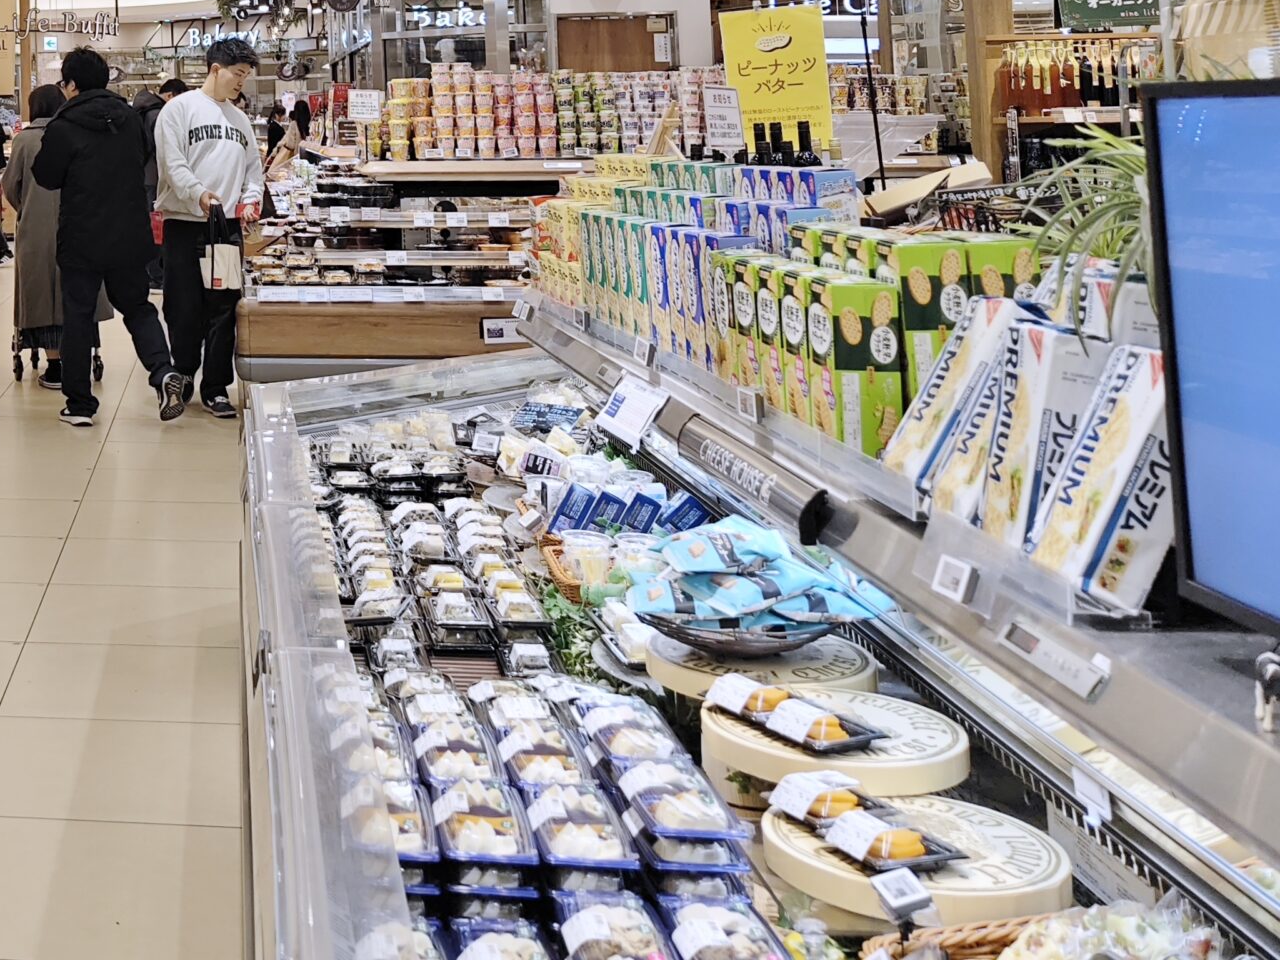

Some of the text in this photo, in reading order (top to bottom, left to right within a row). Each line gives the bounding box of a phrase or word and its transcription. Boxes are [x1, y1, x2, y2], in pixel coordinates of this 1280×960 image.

[61, 11, 120, 41] Buffet
[737, 57, 817, 77] ピーナッツ
[754, 77, 804, 95] バター
[188, 124, 222, 146] PRIVATE
[956, 376, 999, 455] MIUM
[989, 326, 1020, 483] PREMIUM
[1057, 351, 1141, 506] PREMIUM
[699, 439, 765, 497] CHEESE HOUSE
